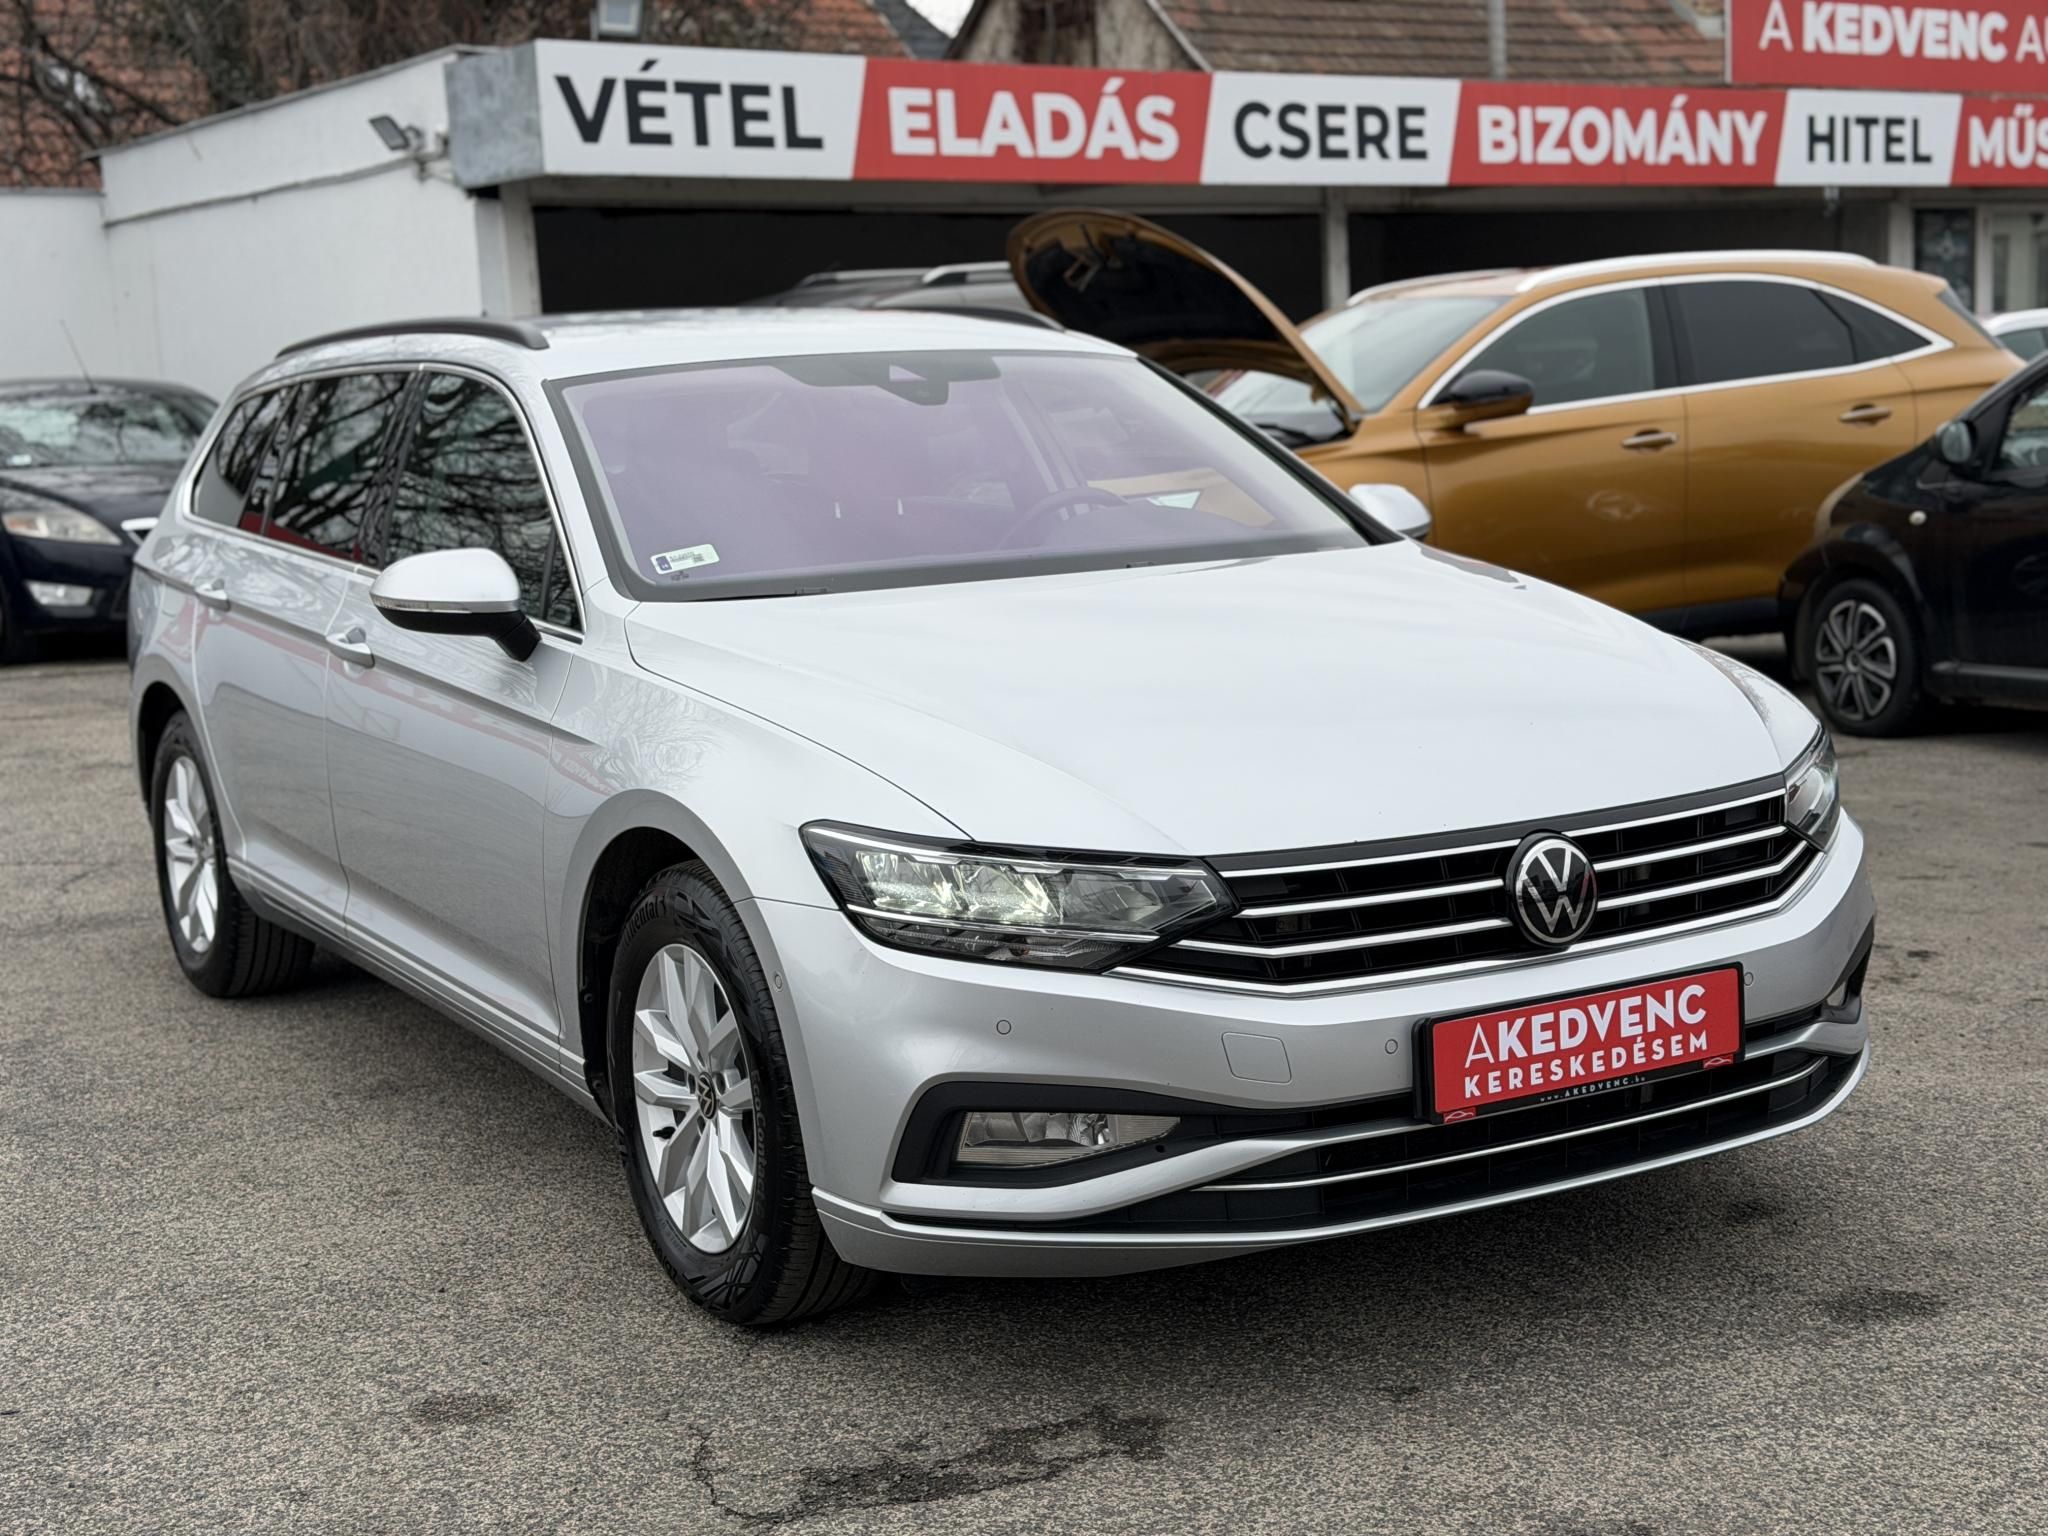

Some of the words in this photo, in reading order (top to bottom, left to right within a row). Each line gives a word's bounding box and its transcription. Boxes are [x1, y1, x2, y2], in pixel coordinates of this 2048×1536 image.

[1759, 0, 1792, 51] A
[1803, 2, 2008, 63] KEDVENC
[2015, 14, 2048, 64] A
[554, 59, 824, 150] VÉTEL
[888, 78, 1180, 161] ELADÁS
[1233, 101, 1428, 160] CSERE
[1477, 95, 1767, 166] BIZOMÁNY
[1807, 115, 1933, 164] HITEL
[1464, 1030, 1708, 1099] KERESKEDÉSEM
